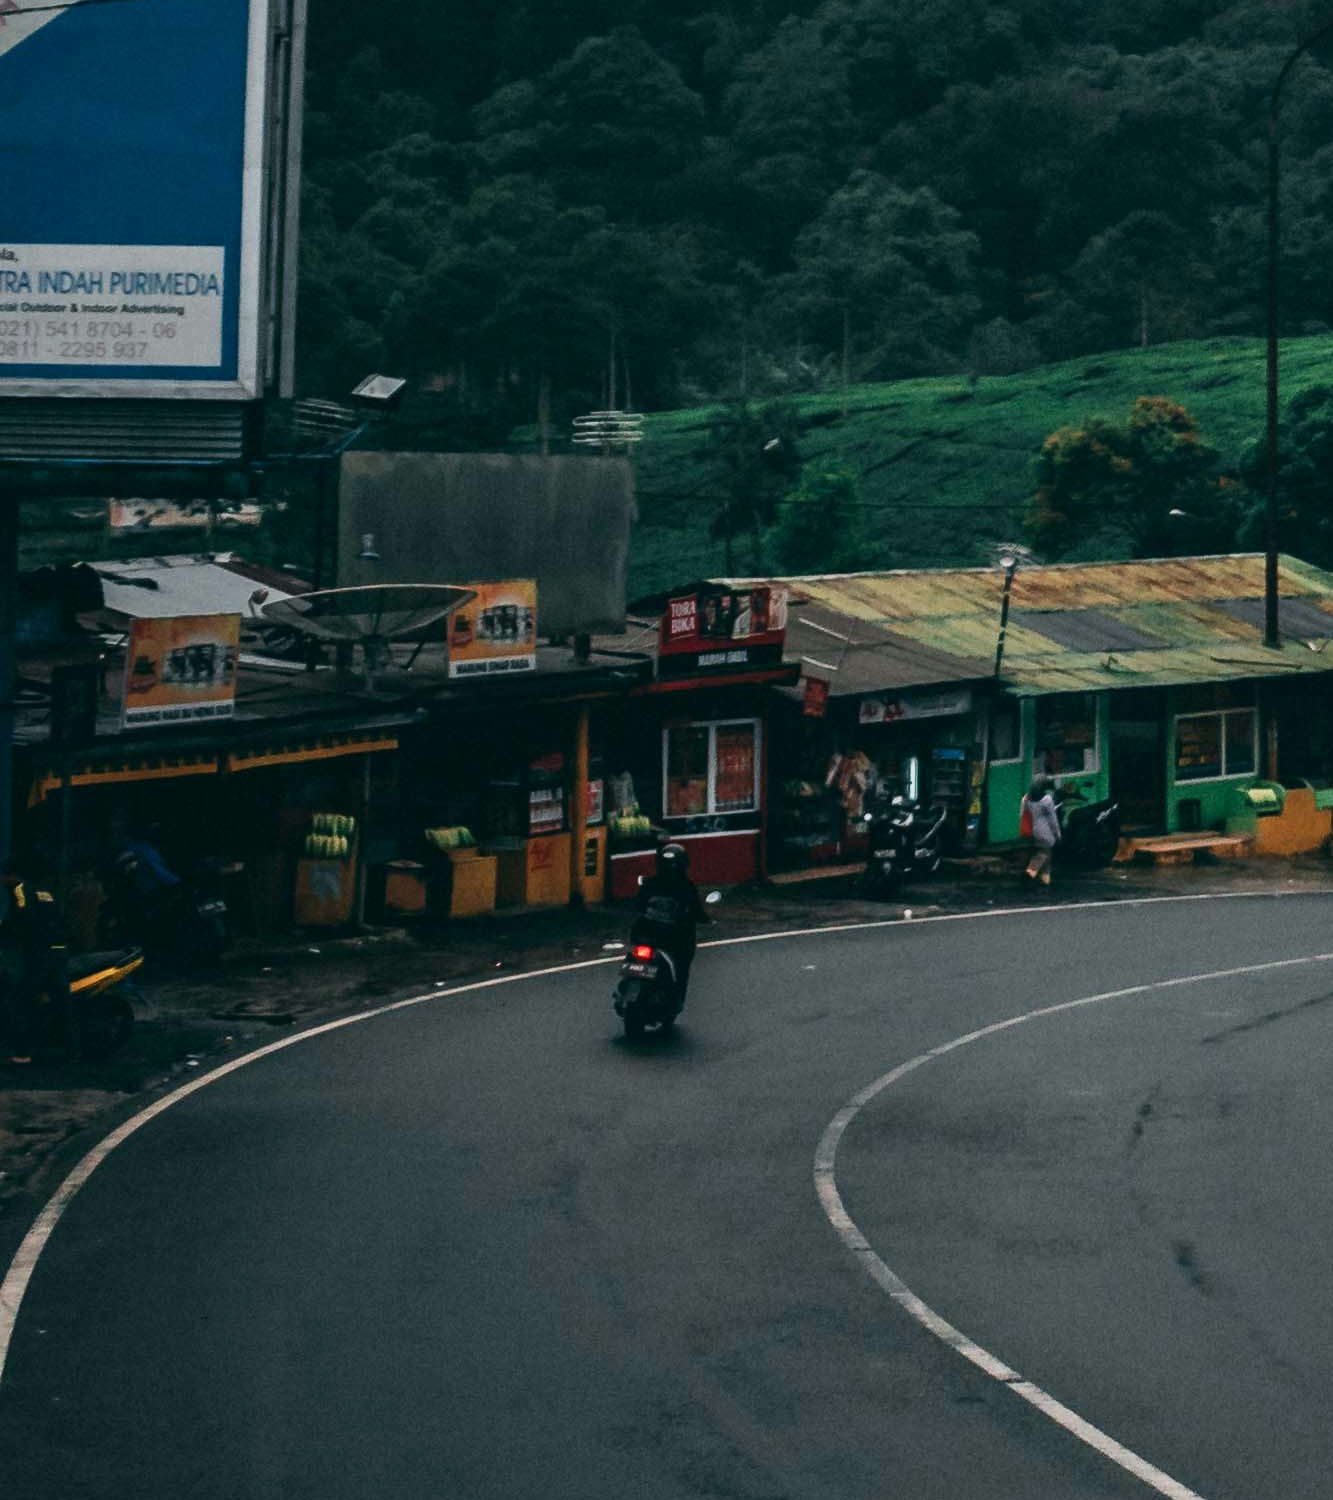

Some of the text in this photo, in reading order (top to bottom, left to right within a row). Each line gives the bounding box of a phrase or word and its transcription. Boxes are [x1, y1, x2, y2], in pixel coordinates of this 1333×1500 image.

[38, 271, 104, 294] INDAH
[109, 271, 220, 296] PURIMEDIA
[20, 302, 66, 313] Outdoor
[70, 303, 78, 313] &
[81, 303, 118, 314] Indoor
[120, 303, 185, 316] Advertising
[45, 321, 79, 337] 541
[86, 321, 133, 338] 8704
[151, 322, 177, 339] 06
[60, 341, 106, 358] 2295
[112, 341, 147, 359] 937
